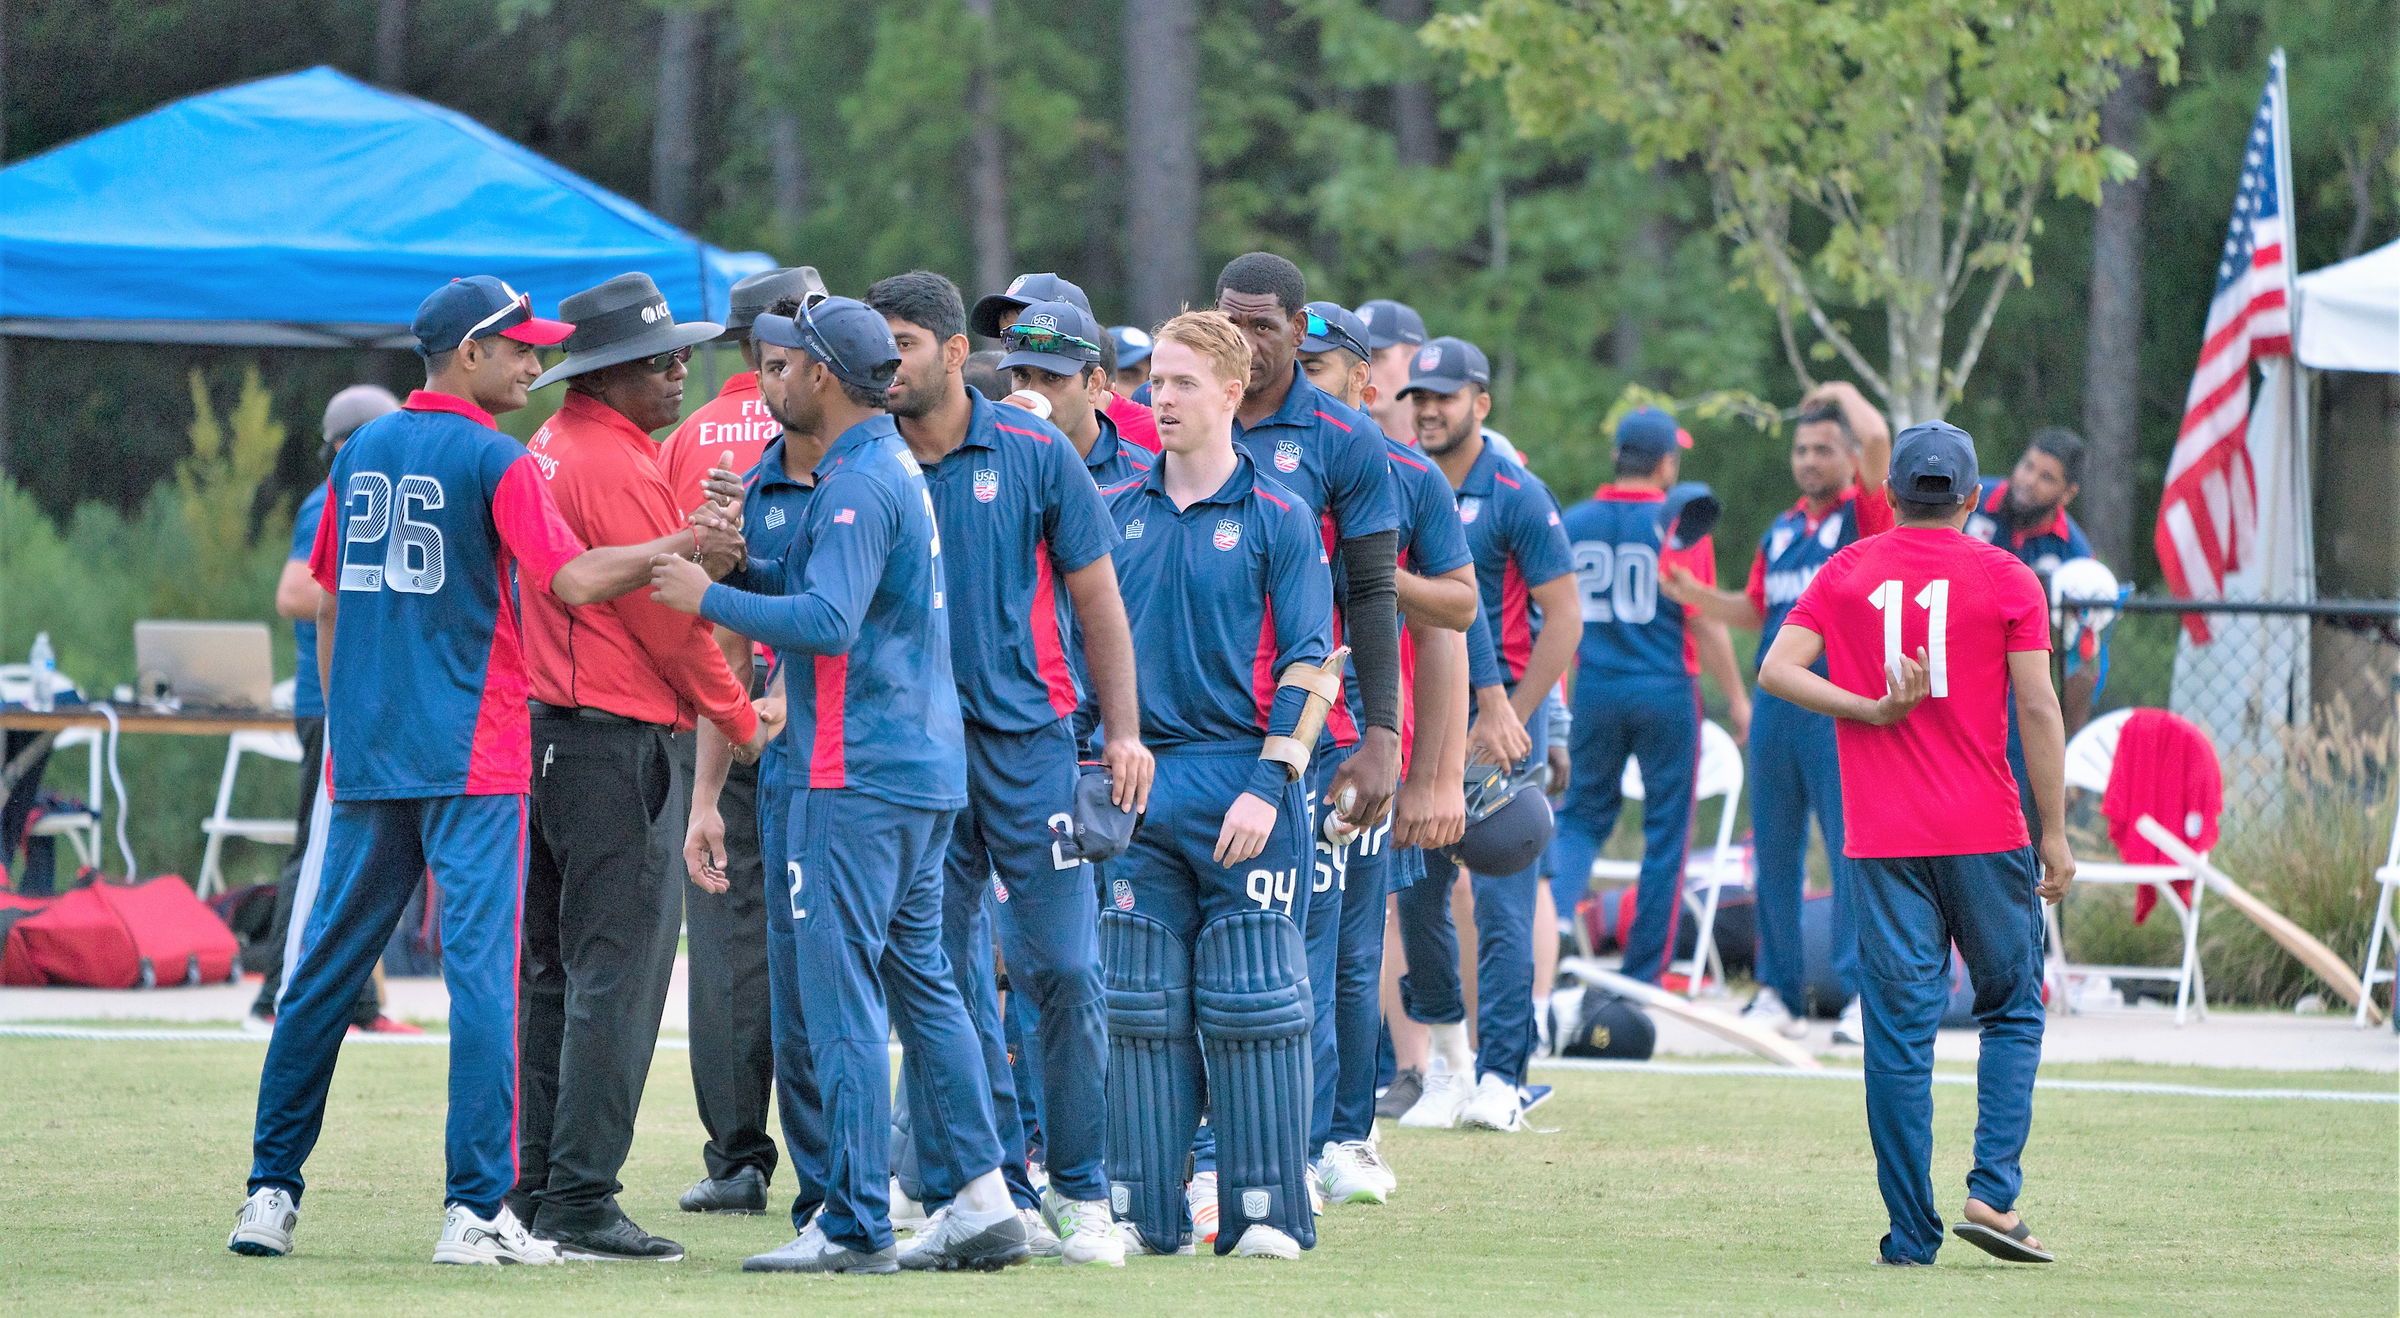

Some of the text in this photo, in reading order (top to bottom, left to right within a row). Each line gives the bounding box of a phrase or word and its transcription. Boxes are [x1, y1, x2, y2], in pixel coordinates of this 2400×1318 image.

[1033, 316, 1055, 327] USA
[535, 426, 552, 449] Fly
[699, 418, 783, 446] Emira
[1279, 441, 1300, 456] USA
[976, 472, 996, 481] USA
[339, 471, 446, 595] 26
[1219, 521, 1240, 533] USA
[1571, 540, 1659, 624] 20
[1867, 579, 1950, 697] 11
[1246, 868, 1297, 916] 94
